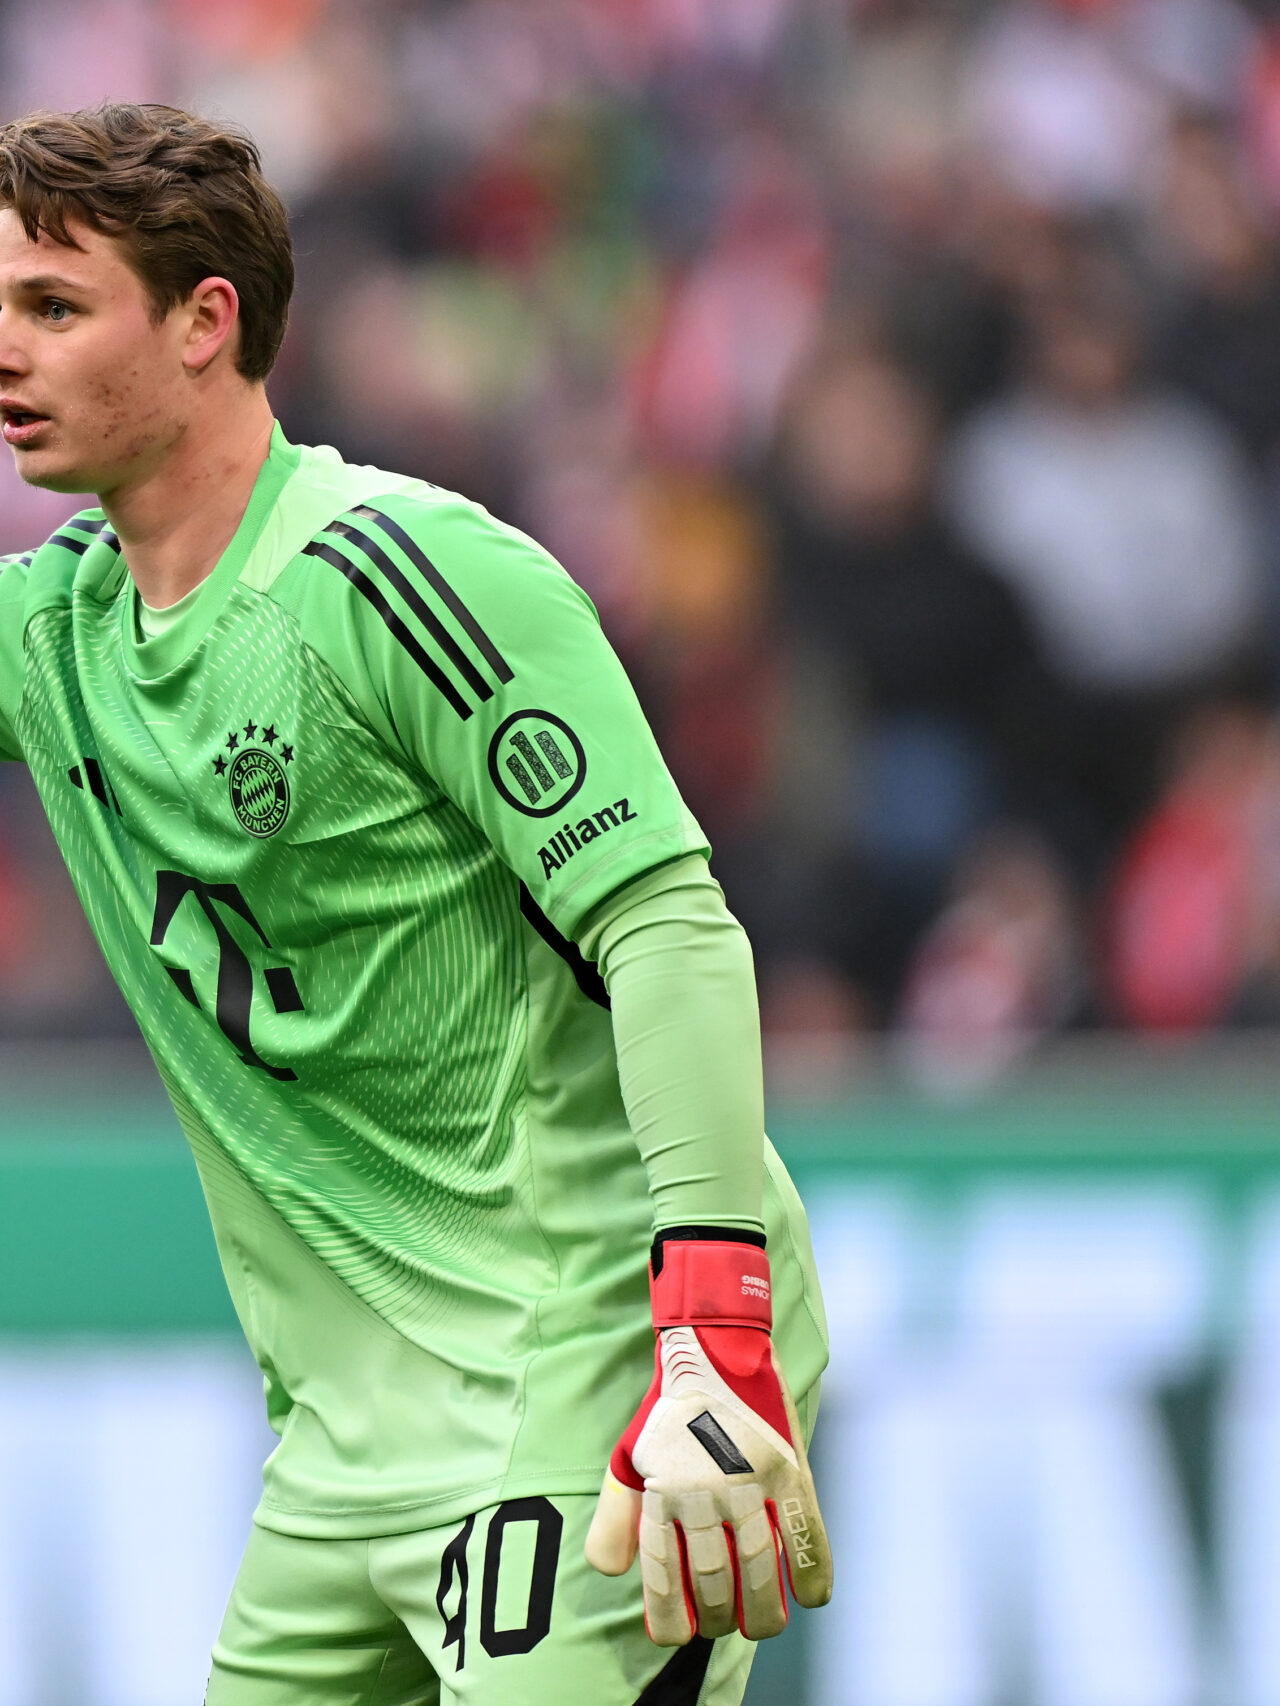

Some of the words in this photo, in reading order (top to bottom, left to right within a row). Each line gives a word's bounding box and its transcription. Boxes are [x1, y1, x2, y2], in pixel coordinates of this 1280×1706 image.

[233, 770, 243, 790] FC
[240, 755, 282, 783] BAYERN
[537, 798, 638, 881] Allianz
[782, 1497, 816, 1569] PRED
